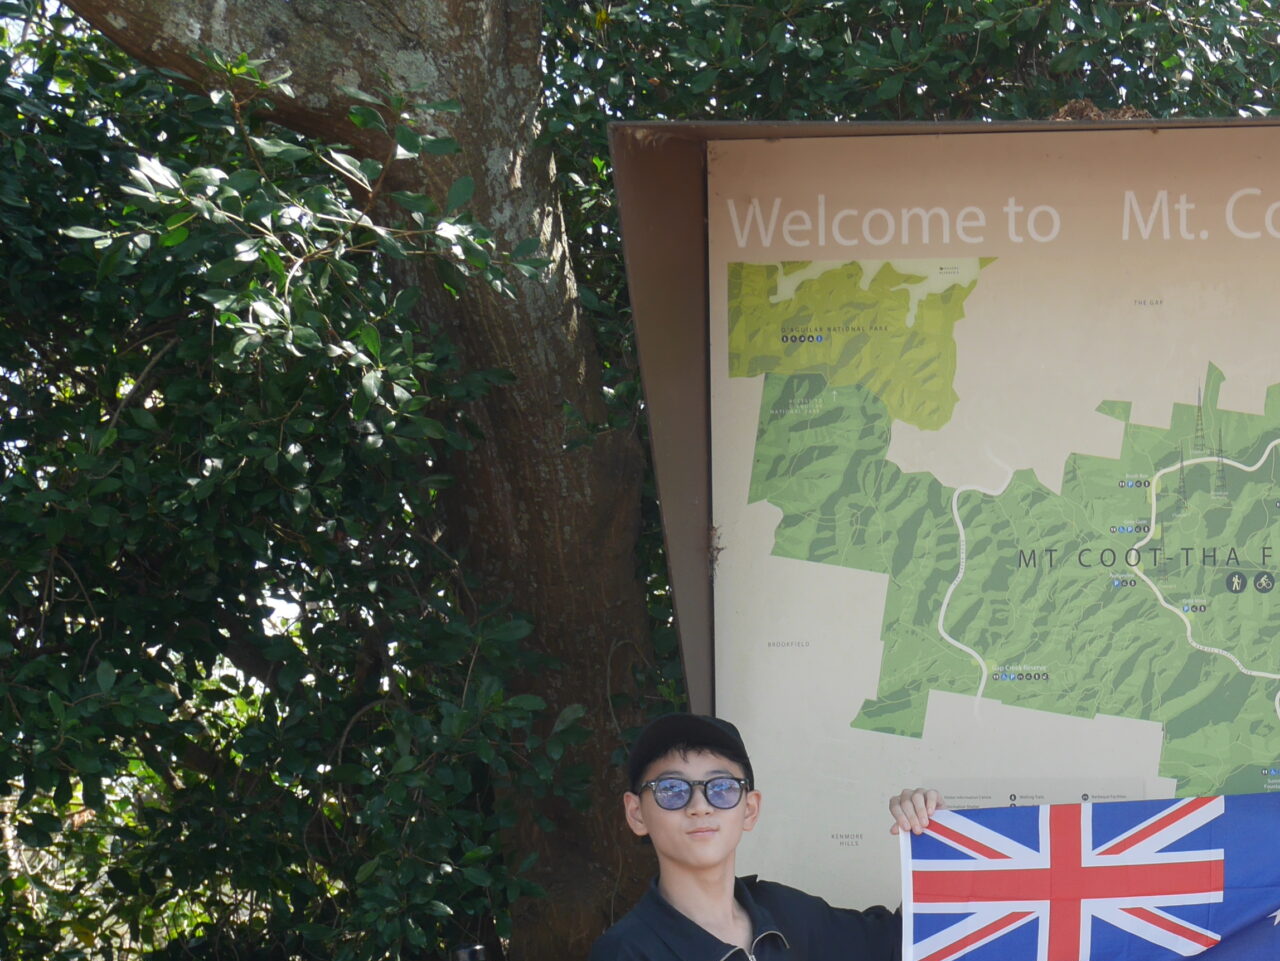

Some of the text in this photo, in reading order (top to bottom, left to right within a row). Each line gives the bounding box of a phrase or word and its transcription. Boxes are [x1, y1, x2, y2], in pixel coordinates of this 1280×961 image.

[727, 194, 987, 248] Welcome
[1003, 197, 1061, 243] to
[1120, 189, 1209, 241] Mt.
[1018, 548, 1058, 568] MT
[1078, 546, 1240, 568] COOT-THA
